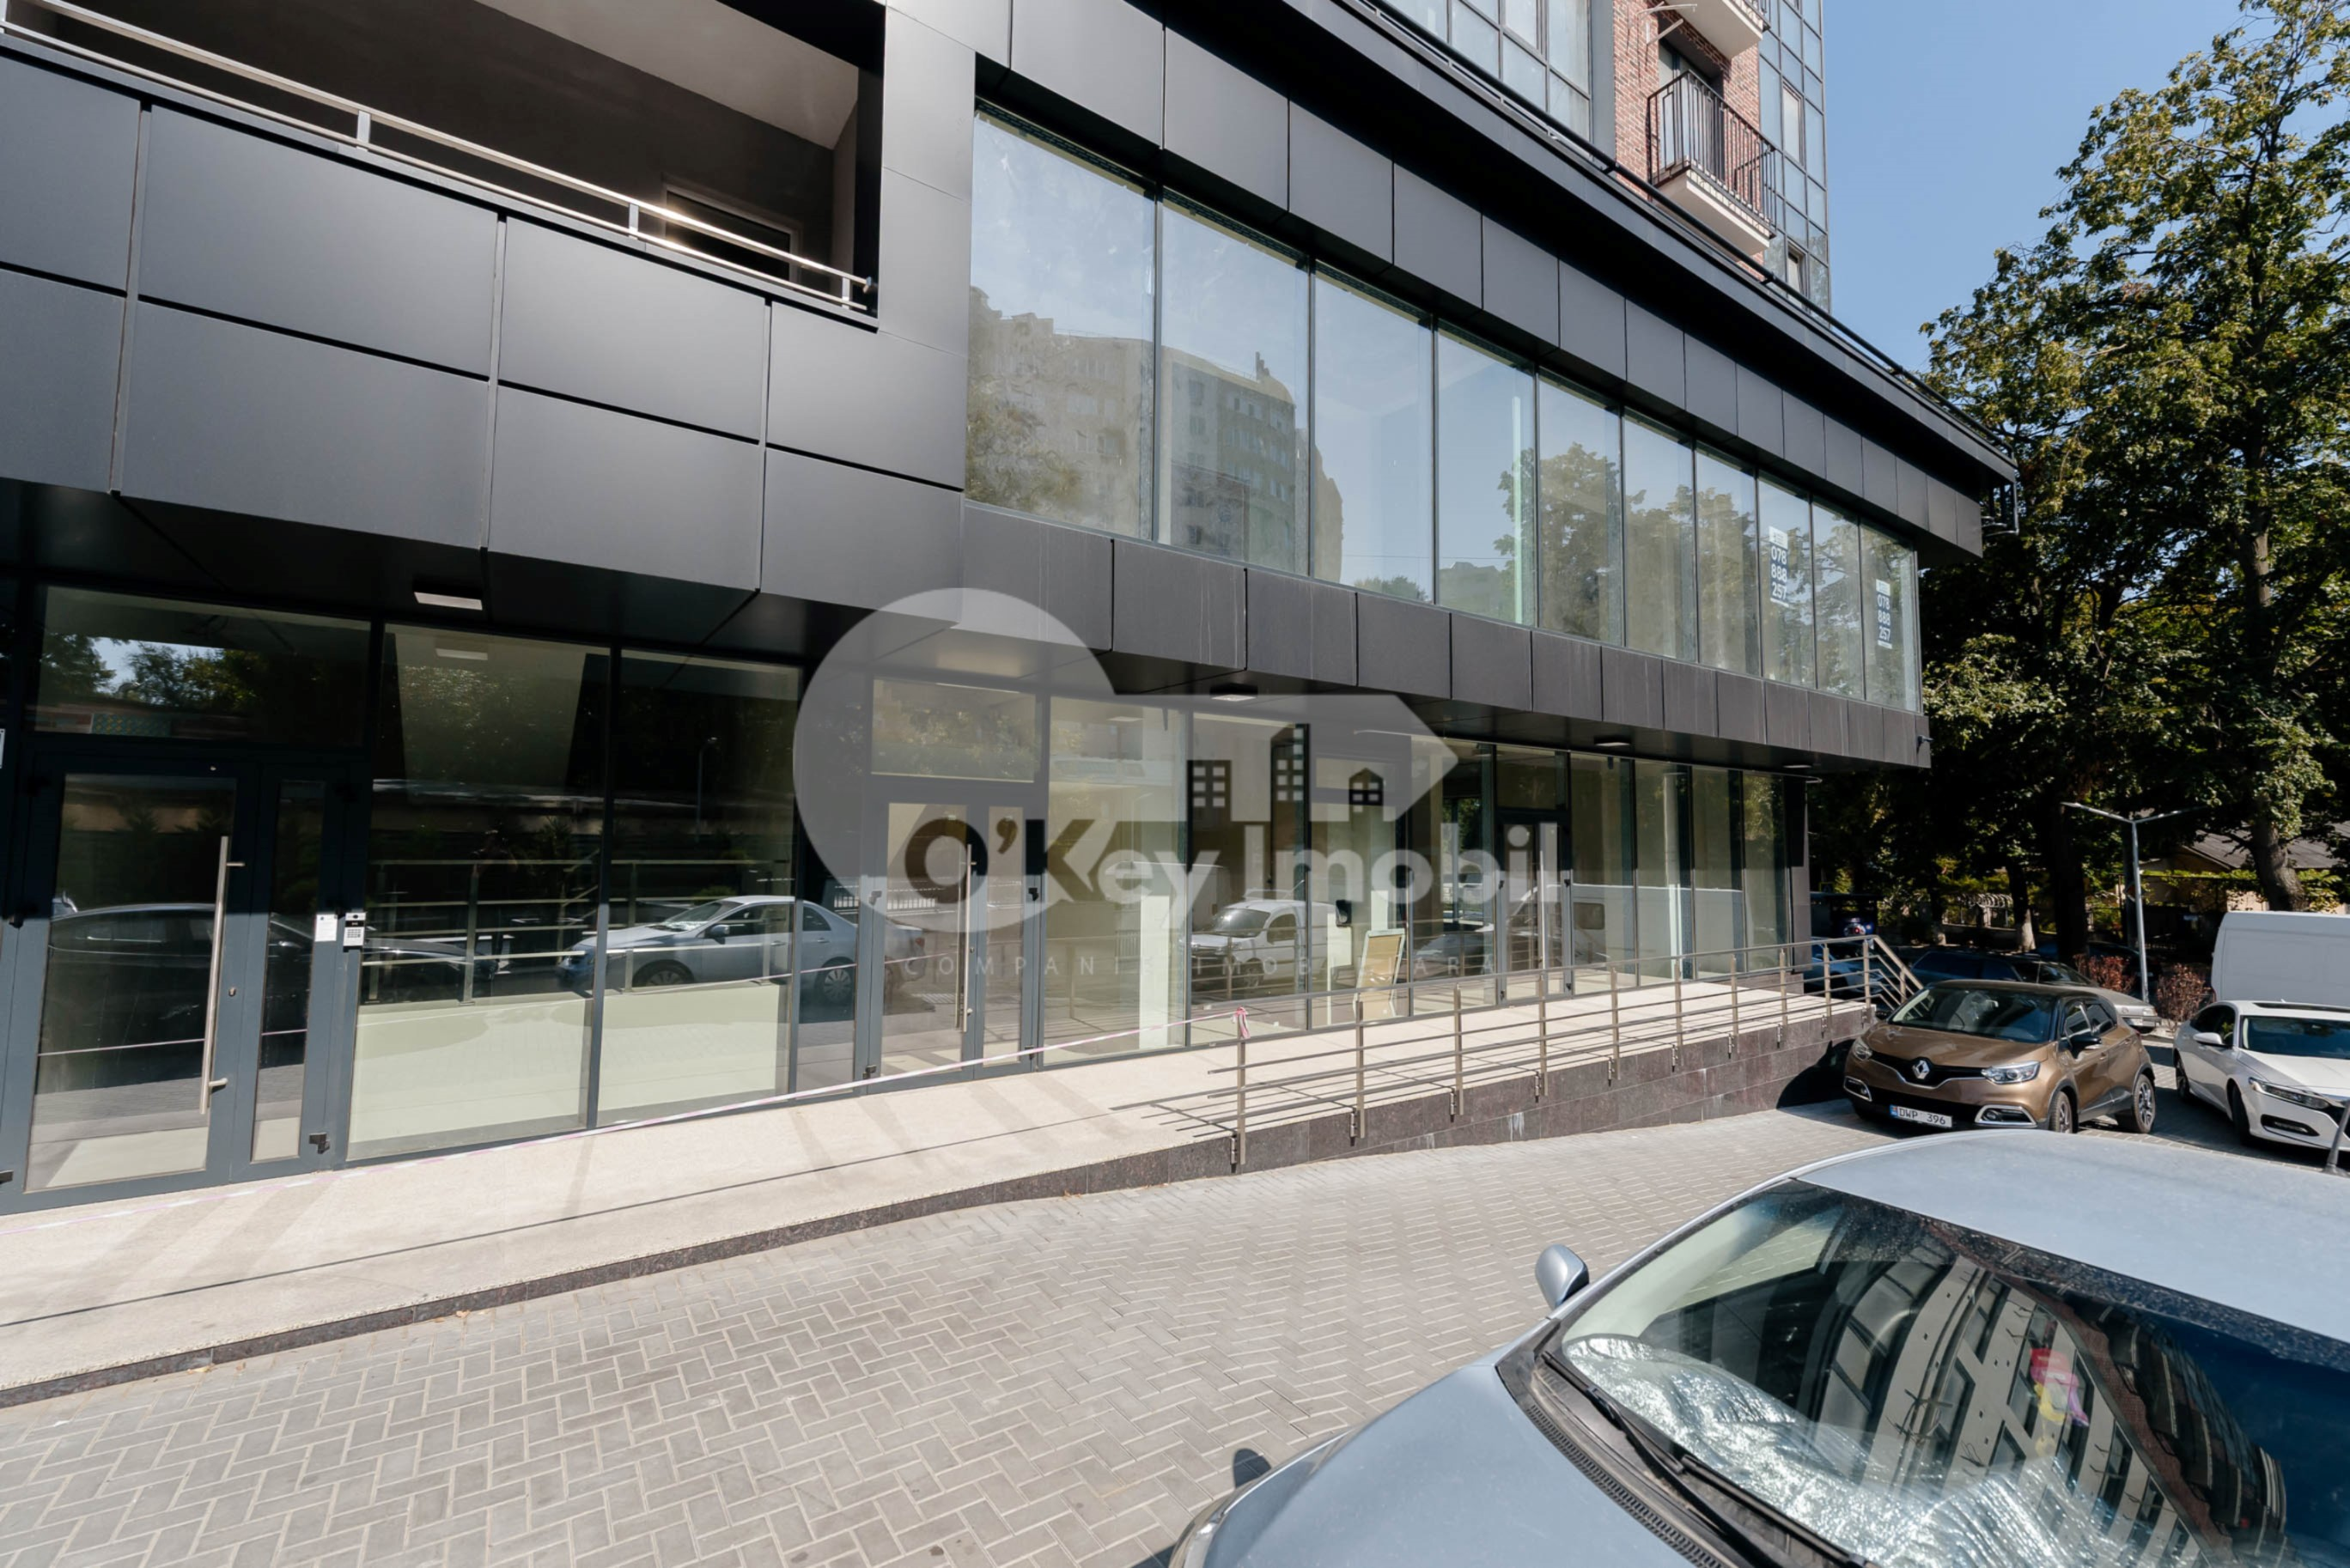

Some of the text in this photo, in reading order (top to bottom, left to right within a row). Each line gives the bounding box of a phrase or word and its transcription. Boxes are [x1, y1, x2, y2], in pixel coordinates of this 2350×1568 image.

[1771, 545, 1787, 565] 078
[1771, 563, 1787, 583] 888
[1772, 581, 1787, 599] 257
[1878, 609, 1891, 626] 888
[1927, 1113, 1946, 1125] 396
